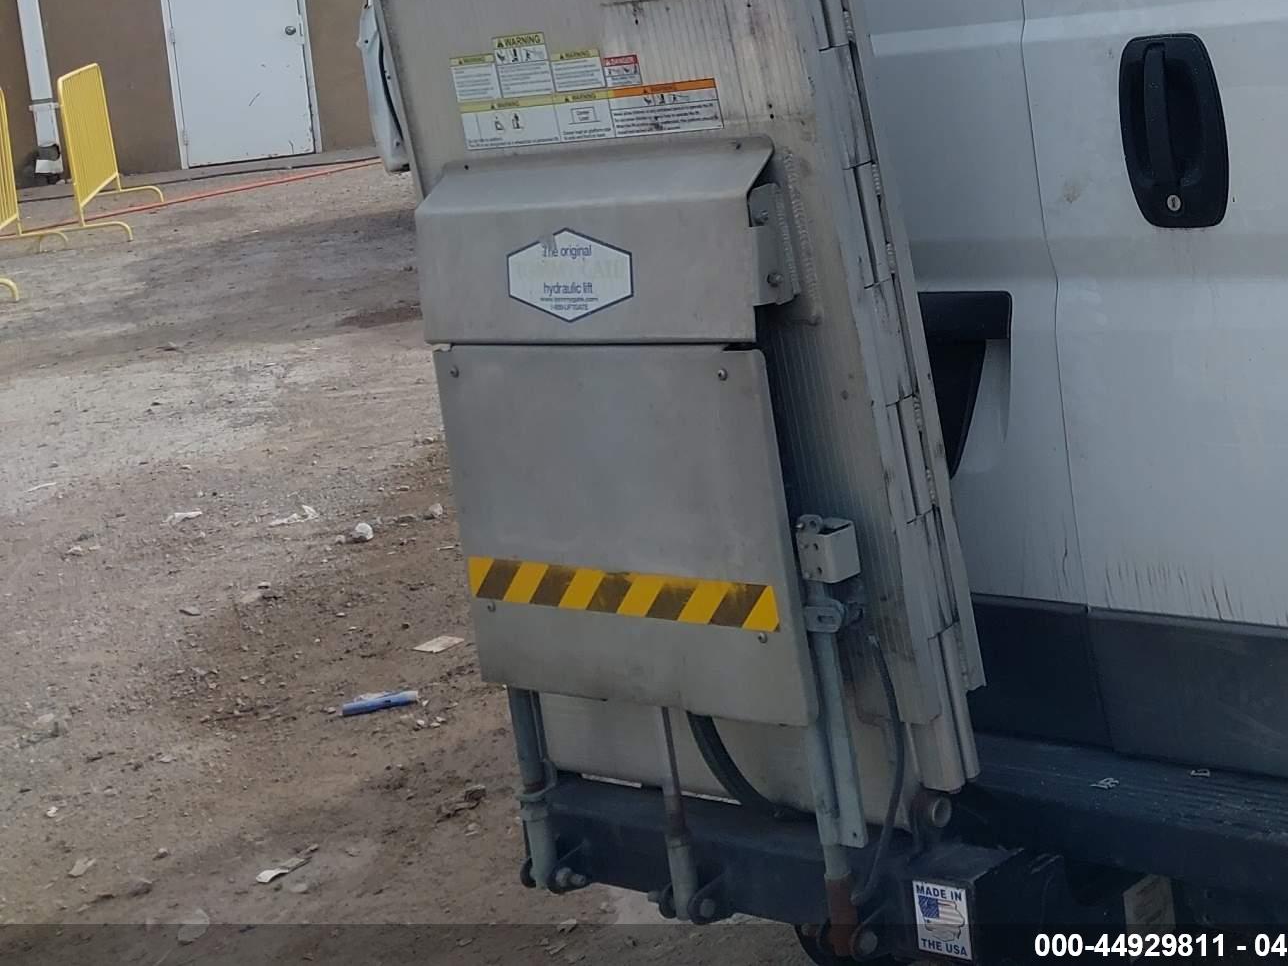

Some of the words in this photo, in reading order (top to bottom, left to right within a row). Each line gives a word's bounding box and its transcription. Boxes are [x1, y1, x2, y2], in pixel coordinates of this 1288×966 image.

[505, 34, 541, 46] WARNING
[560, 244, 592, 259] original
[543, 282, 581, 297] hydraulic
[583, 282, 593, 293] lift
[916, 884, 946, 899] MADE
[951, 890, 962, 901] IN
[921, 938, 942, 951] THE
[946, 944, 968, 957] USA
